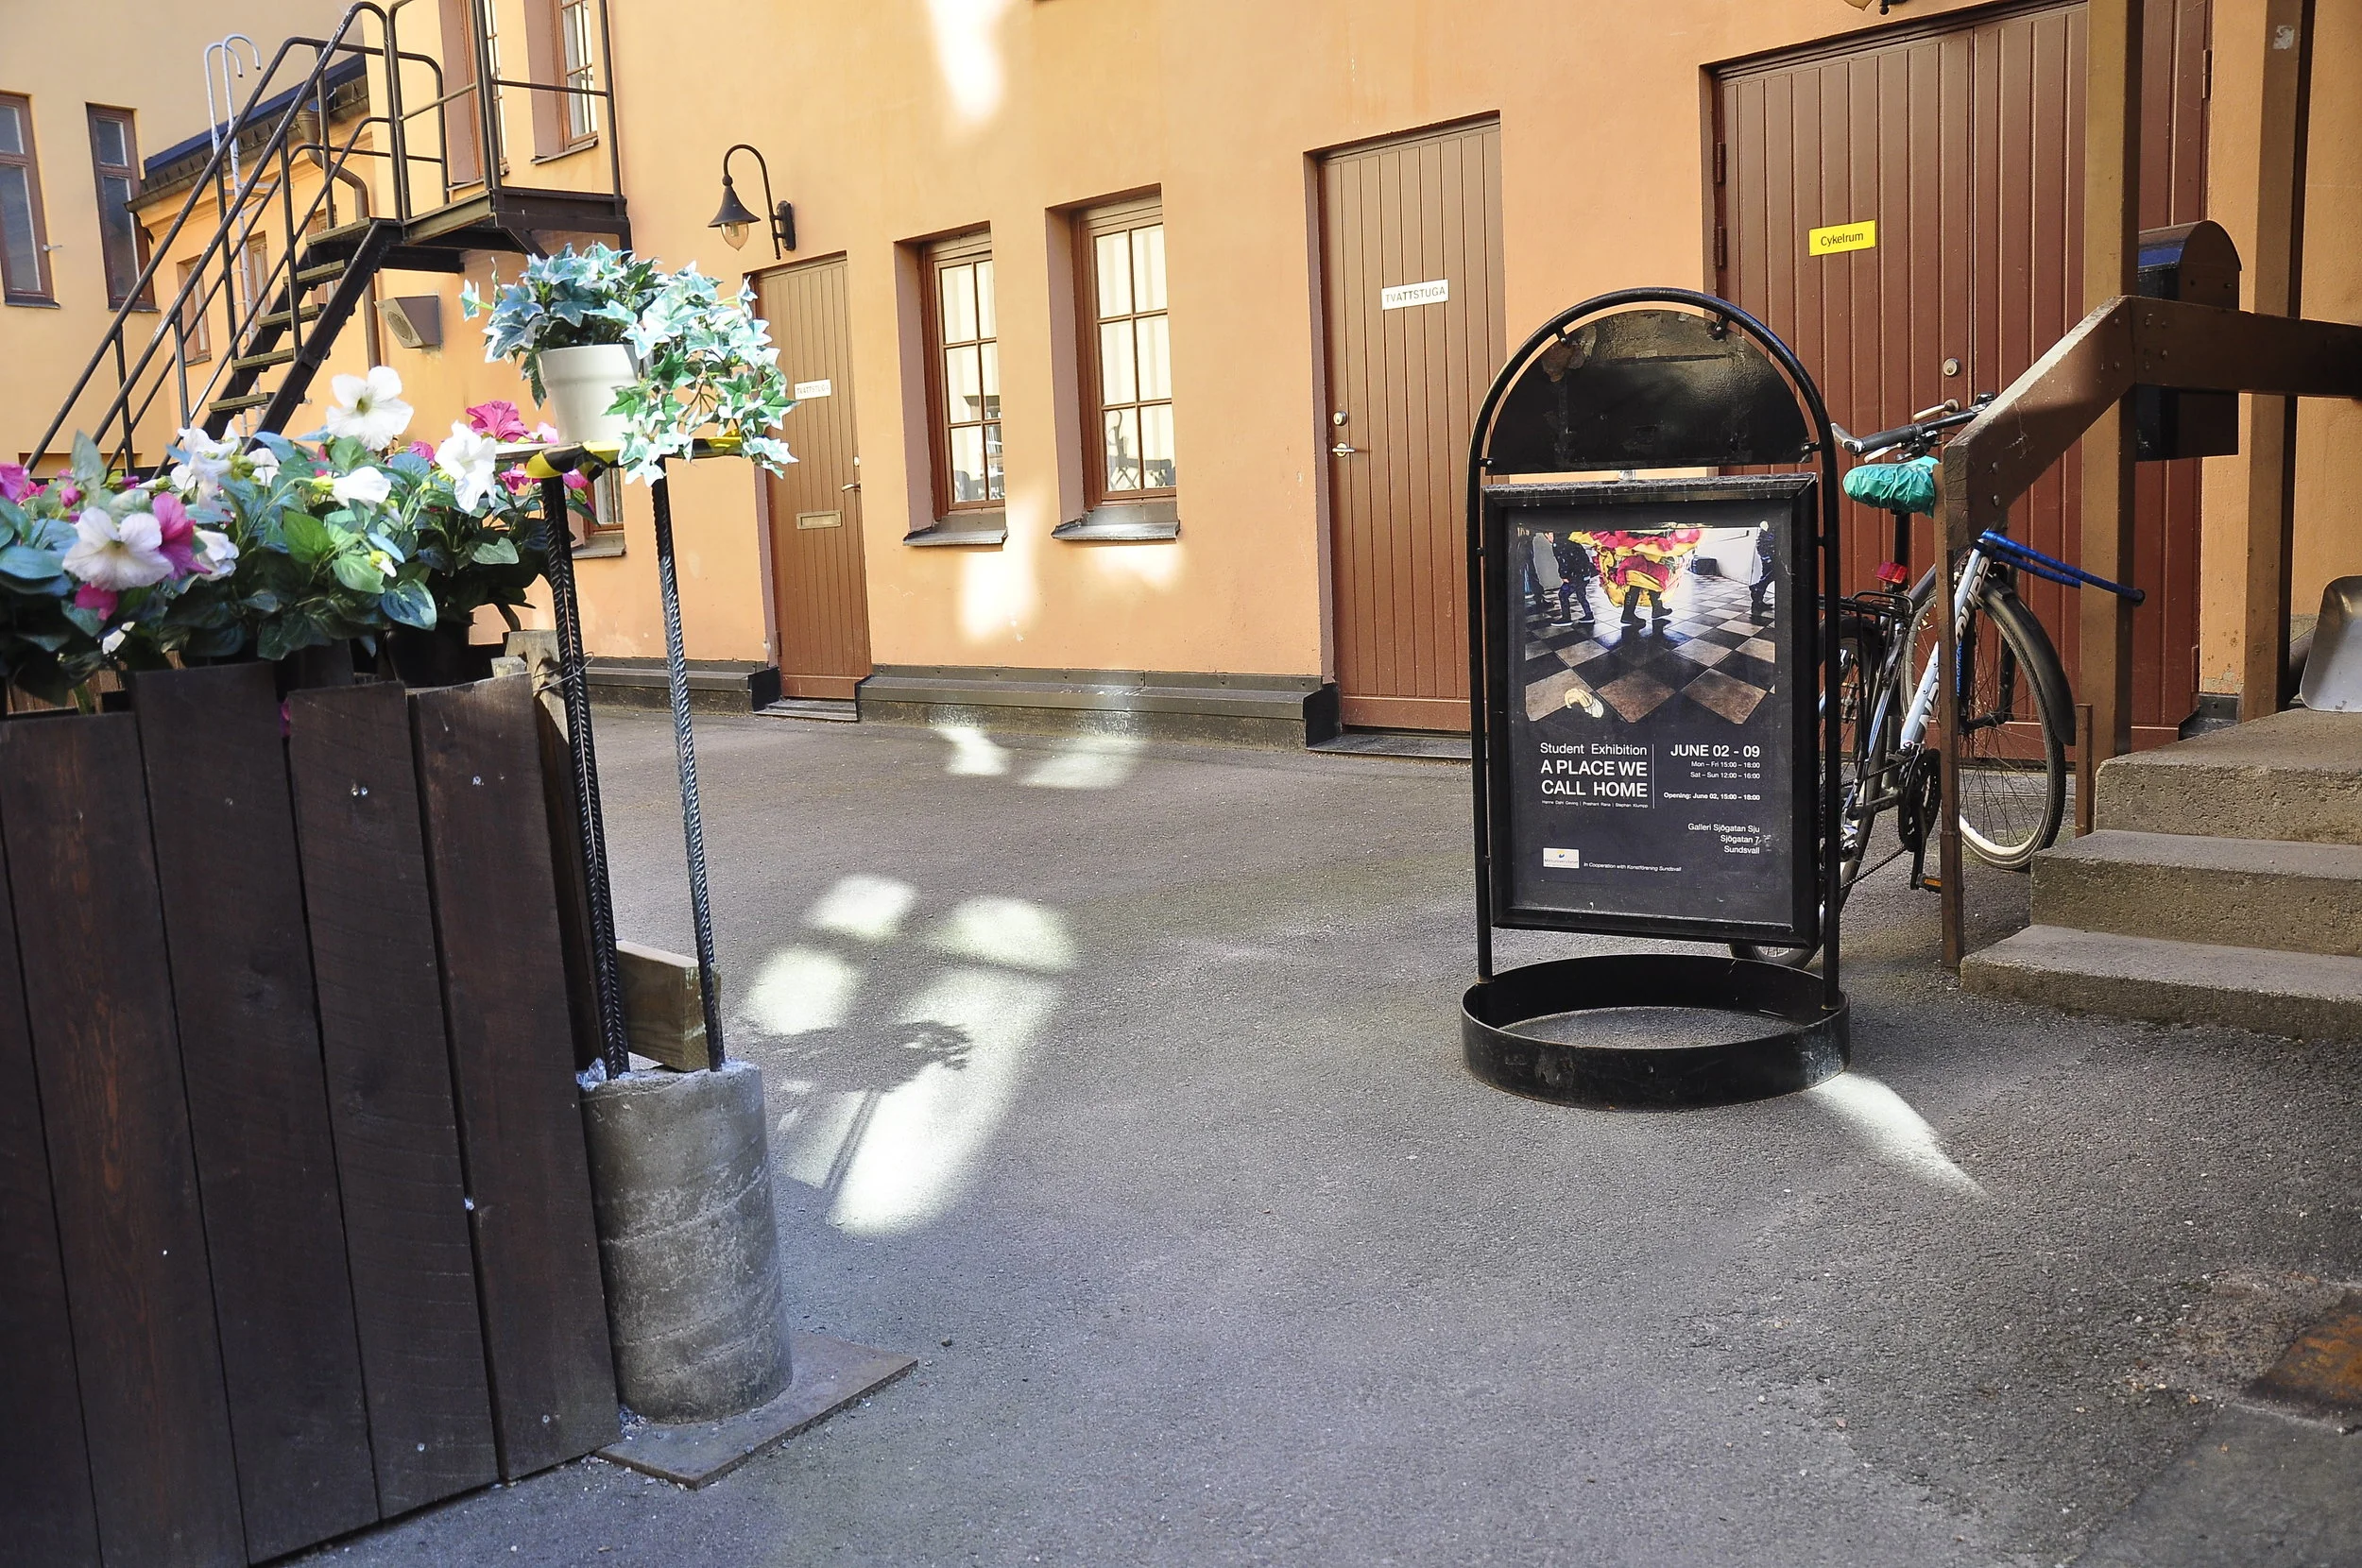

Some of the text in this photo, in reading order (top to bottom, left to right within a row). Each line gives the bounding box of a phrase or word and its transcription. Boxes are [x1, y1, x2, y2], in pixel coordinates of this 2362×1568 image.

[1820, 232, 1864, 247] Cykelrum
[1540, 741, 1648, 756] Student Exhibition
[1669, 744, 1709, 757] JUNE
[1712, 744, 1730, 758] 02
[1743, 745, 1760, 758] 09
[1540, 759, 1648, 776] A PLACE WE
[1541, 779, 1648, 797] CALL HOME
[1663, 792, 1691, 800] Opening:
[1687, 823, 1760, 834] Galleri Sjögatan Sju
[1723, 845, 1760, 854] Sundsvall
